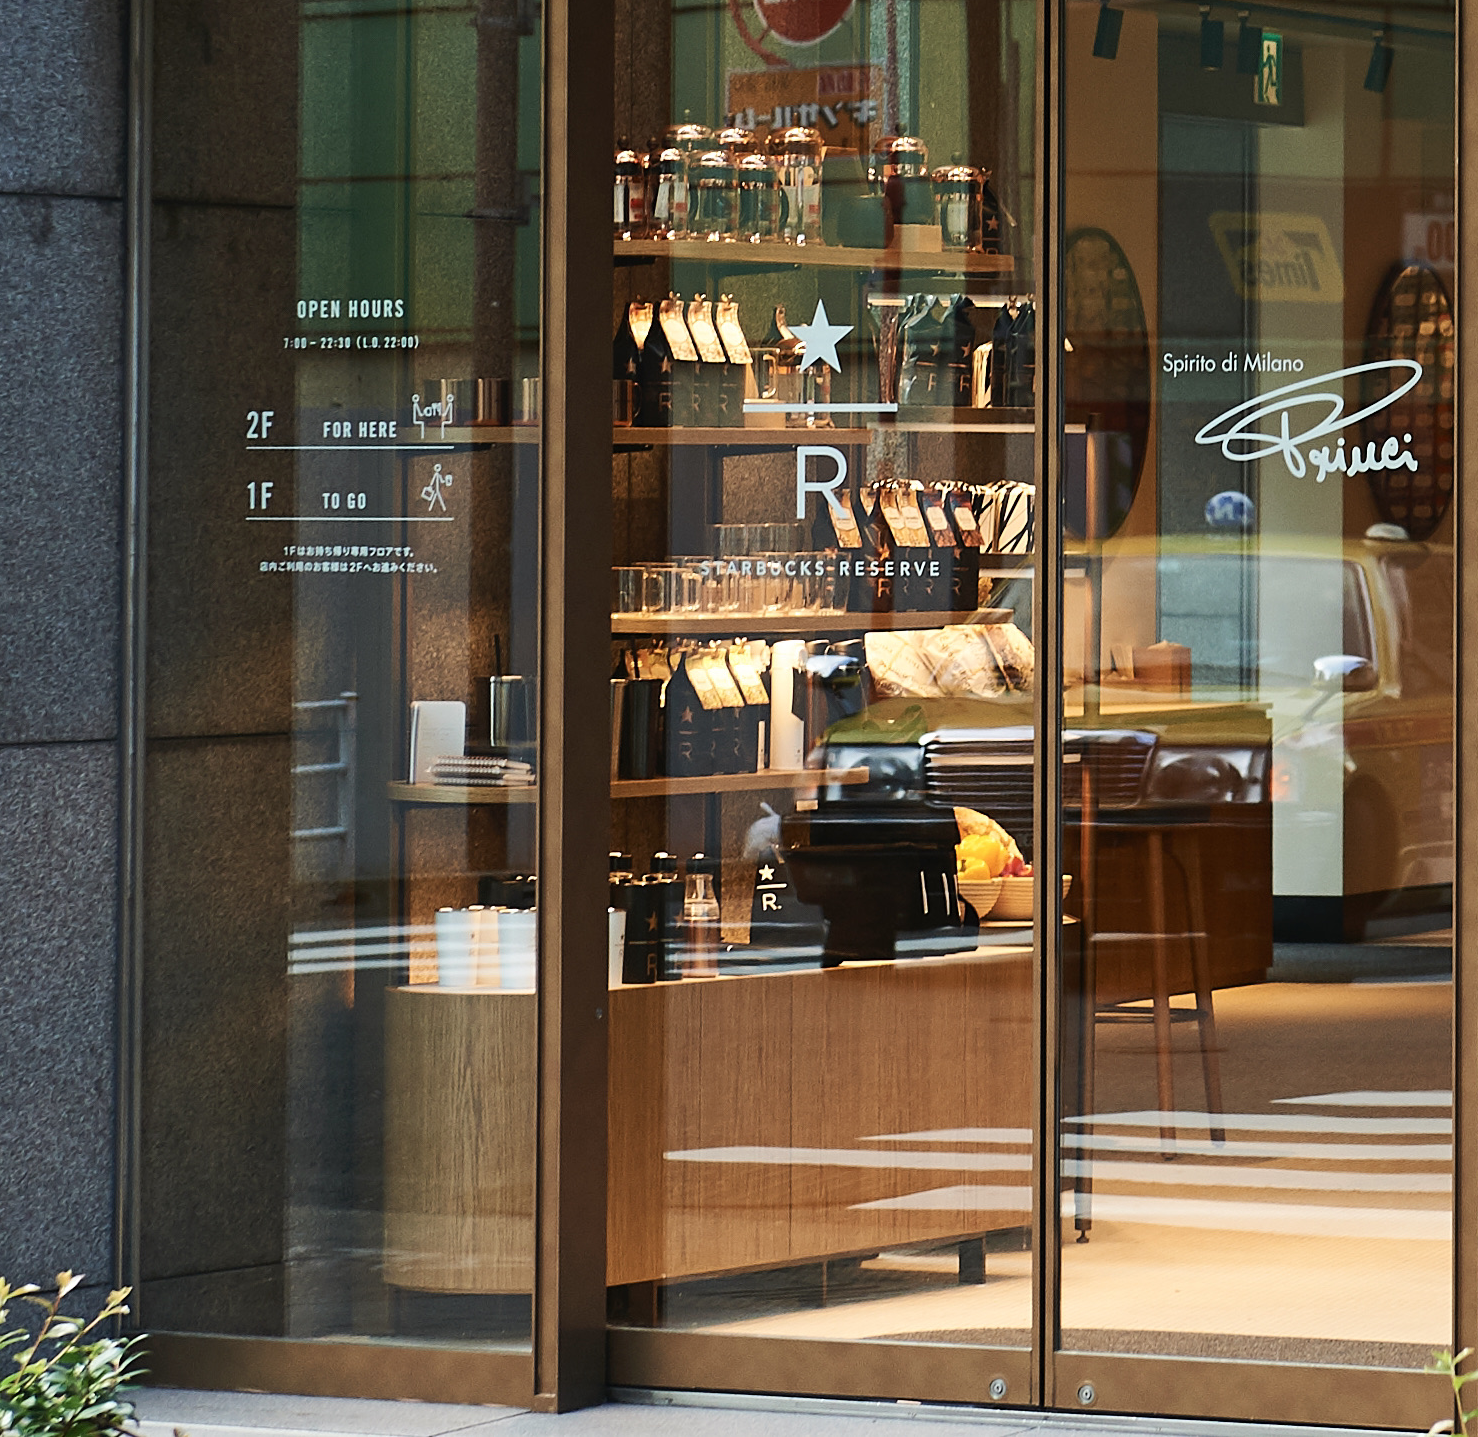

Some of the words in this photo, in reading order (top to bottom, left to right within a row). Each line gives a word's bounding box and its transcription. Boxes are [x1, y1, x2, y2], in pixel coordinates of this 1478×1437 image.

[297, 299, 340, 319] OPEN
[348, 299, 404, 318] HOURS
[283, 336, 308, 349] 7:00
[320, 336, 351, 349] 22:30
[383, 334, 420, 349] 22:00)
[1162, 351, 1216, 378] Spirito
[1221, 350, 1238, 373] di
[1243, 350, 1305, 374] Milano
[246, 410, 274, 440] 2F
[322, 421, 352, 439] FOR
[358, 421, 398, 439] HERE
[247, 481, 274, 510] 1F
[322, 492, 340, 510] TO
[347, 492, 367, 510] GO
[795, 445, 851, 520] R
[699, 560, 826, 578] STARBUCKS
[839, 560, 942, 578] RESERVE
